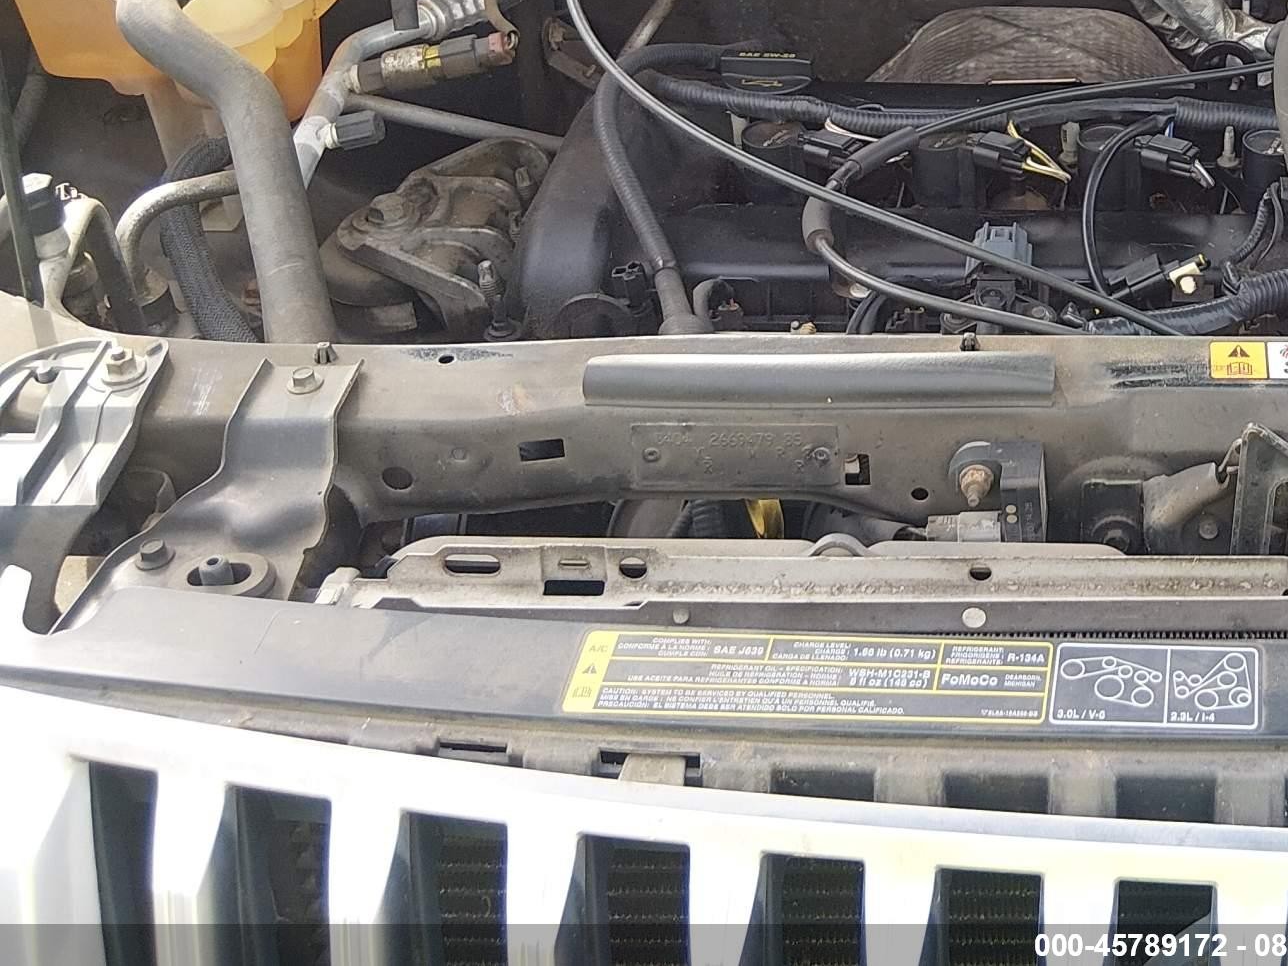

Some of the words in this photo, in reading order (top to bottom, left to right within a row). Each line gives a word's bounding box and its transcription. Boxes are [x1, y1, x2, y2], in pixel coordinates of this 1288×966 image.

[713, 645, 737, 654] SAE
[876, 648, 887, 657] lb
[889, 647, 915, 659] (0.71
[918, 649, 936, 660] kg)
[940, 673, 999, 686] FoMoCo
[1057, 709, 1079, 718] 3.0L
[1170, 713, 1193, 722] 2.3L
